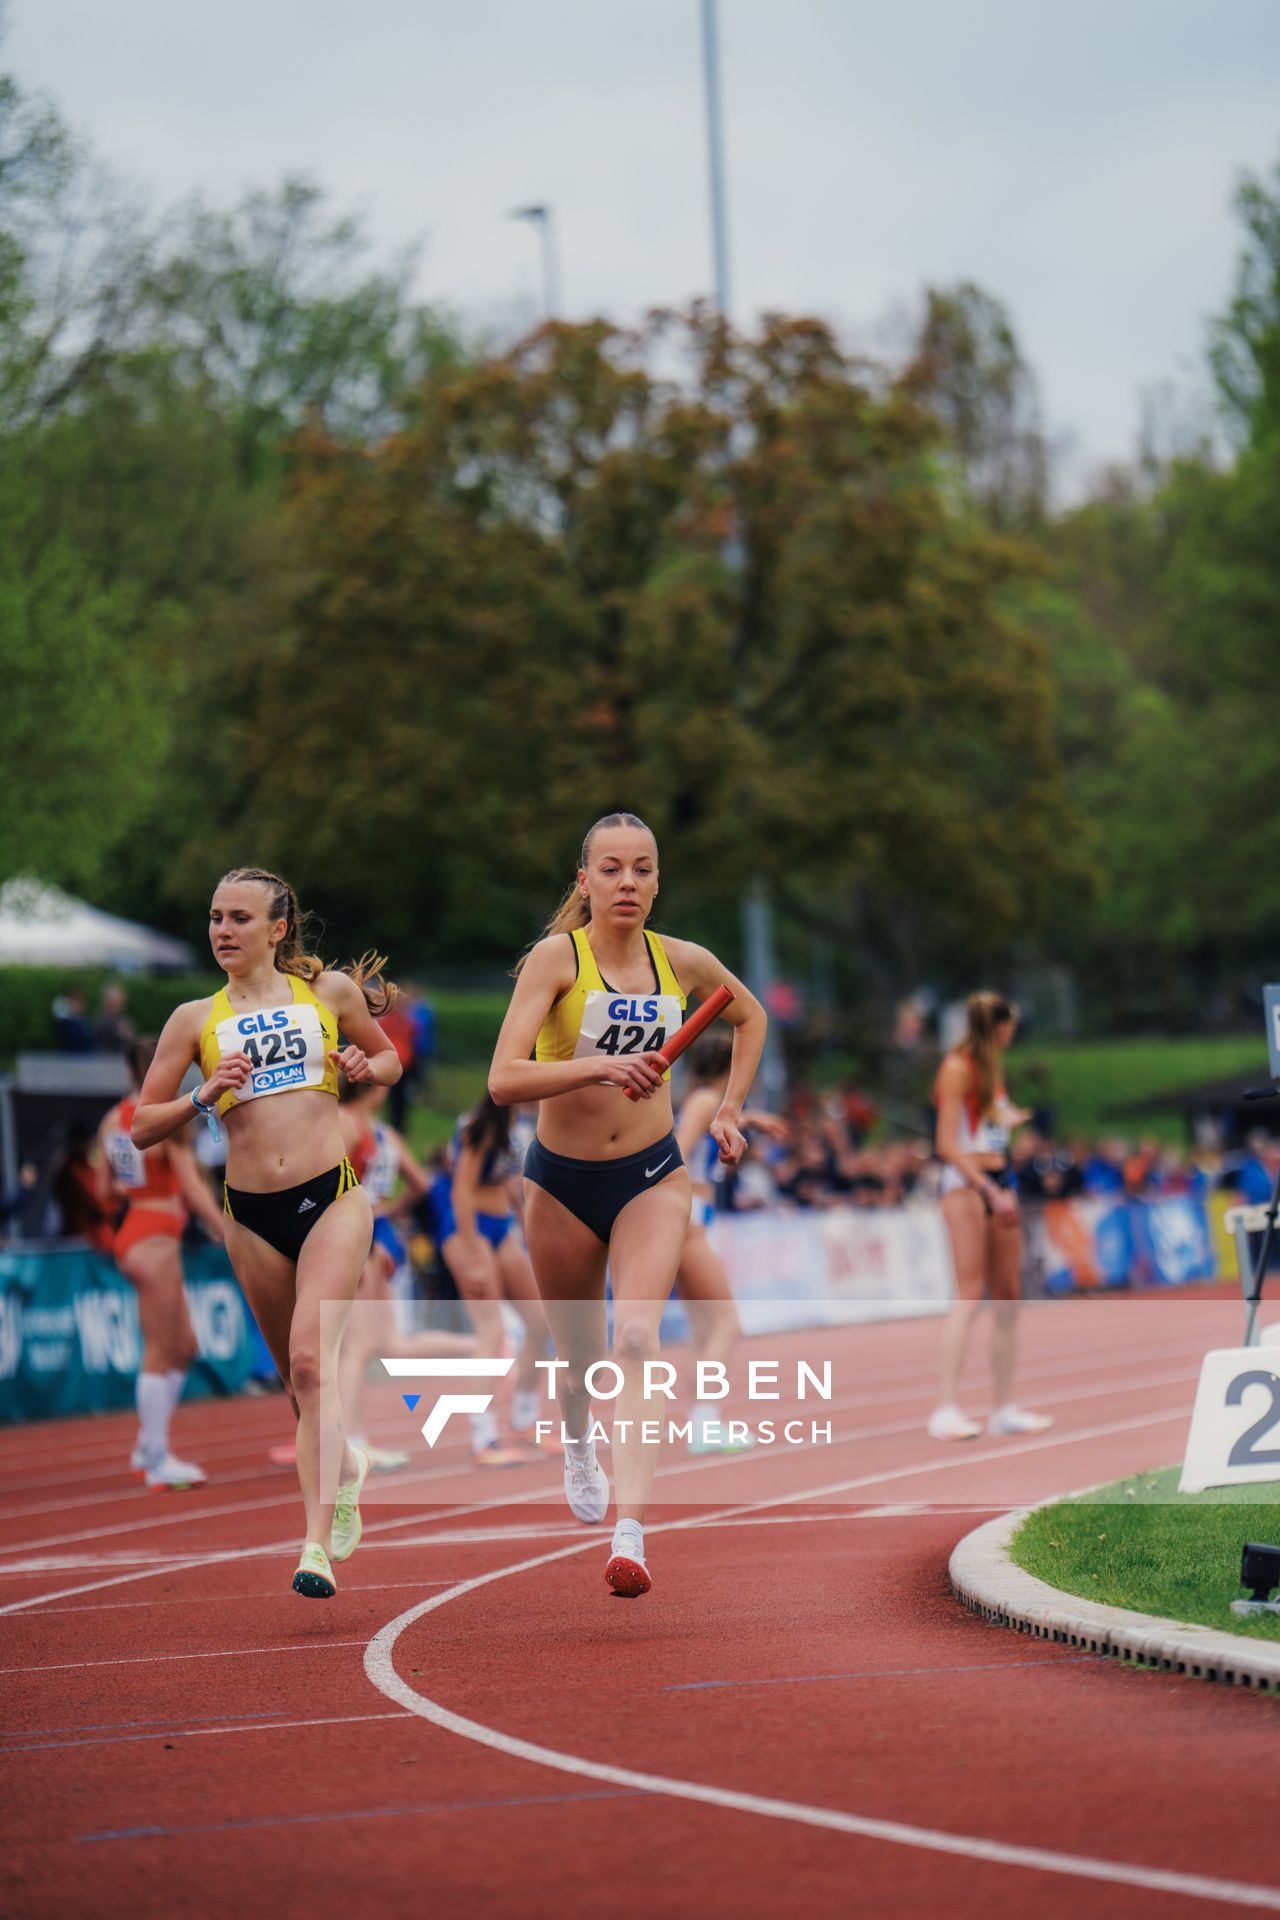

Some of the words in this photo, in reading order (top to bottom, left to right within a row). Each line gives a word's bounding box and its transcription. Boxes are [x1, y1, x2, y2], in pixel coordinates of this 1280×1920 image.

[243, 1028, 307, 1068] 425
[596, 1025, 666, 1056] 424
[273, 1066, 303, 1082] PLAN
[1224, 1370, 1280, 1468] 2
